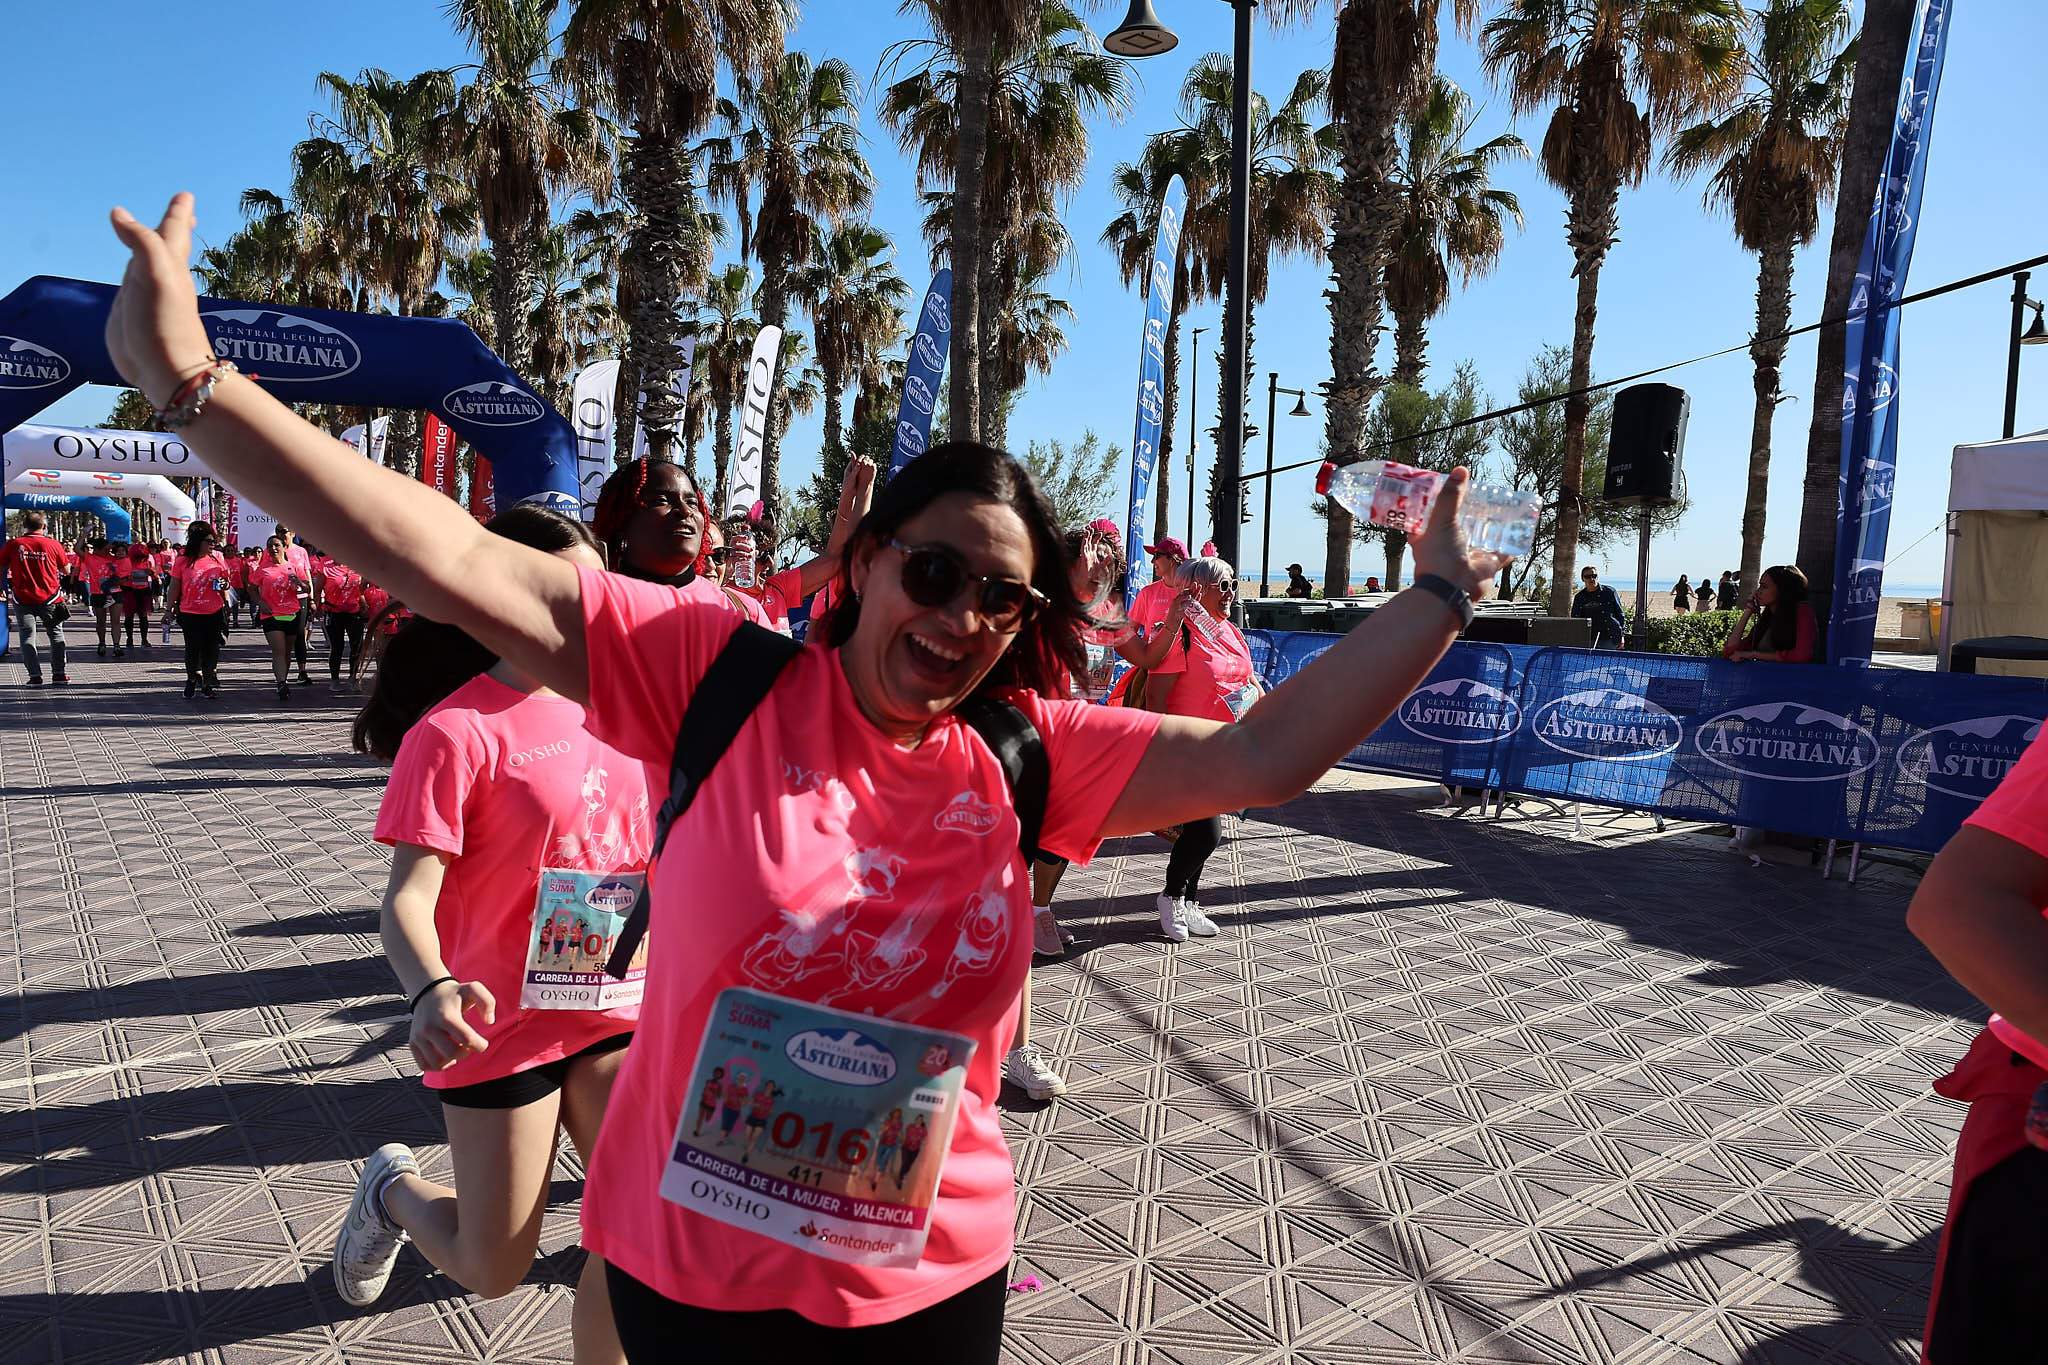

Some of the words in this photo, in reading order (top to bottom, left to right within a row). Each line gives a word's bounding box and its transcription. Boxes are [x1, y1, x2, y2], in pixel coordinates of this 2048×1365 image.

[216, 325, 277, 340] CENTRAL
[283, 332, 342, 346] LECHERA
[214, 336, 348, 370] STURIANA
[0, 361, 60, 380] RIANA
[452, 396, 540, 416] ASTURIANA
[53, 435, 191, 465] OYSHO
[1405, 698, 1511, 731] ASTURIANA
[1540, 709, 1668, 746] ASTURIANA
[509, 740, 570, 767] OYSHO
[1706, 725, 1863, 767] ASTURIANA
[584, 934, 615, 956] 01
[535, 973, 574, 983] CARRERA
[575, 974, 587, 984] DE
[588, 975, 599, 984] LA
[540, 989, 590, 1002] OYSHO
[791, 1038, 889, 1079] ASTURIANA
[771, 1111, 872, 1166] 016
[686, 1151, 746, 1184] CARRERA
[750, 1173, 768, 1191] DE
[771, 1183, 789, 1198] LA
[792, 1189, 841, 1213] MUJER
[853, 1202, 914, 1225] VALENCIA
[788, 1165, 824, 1187] 411
[690, 1179, 771, 1221] OYSHO
[821, 1227, 897, 1254] Santander
